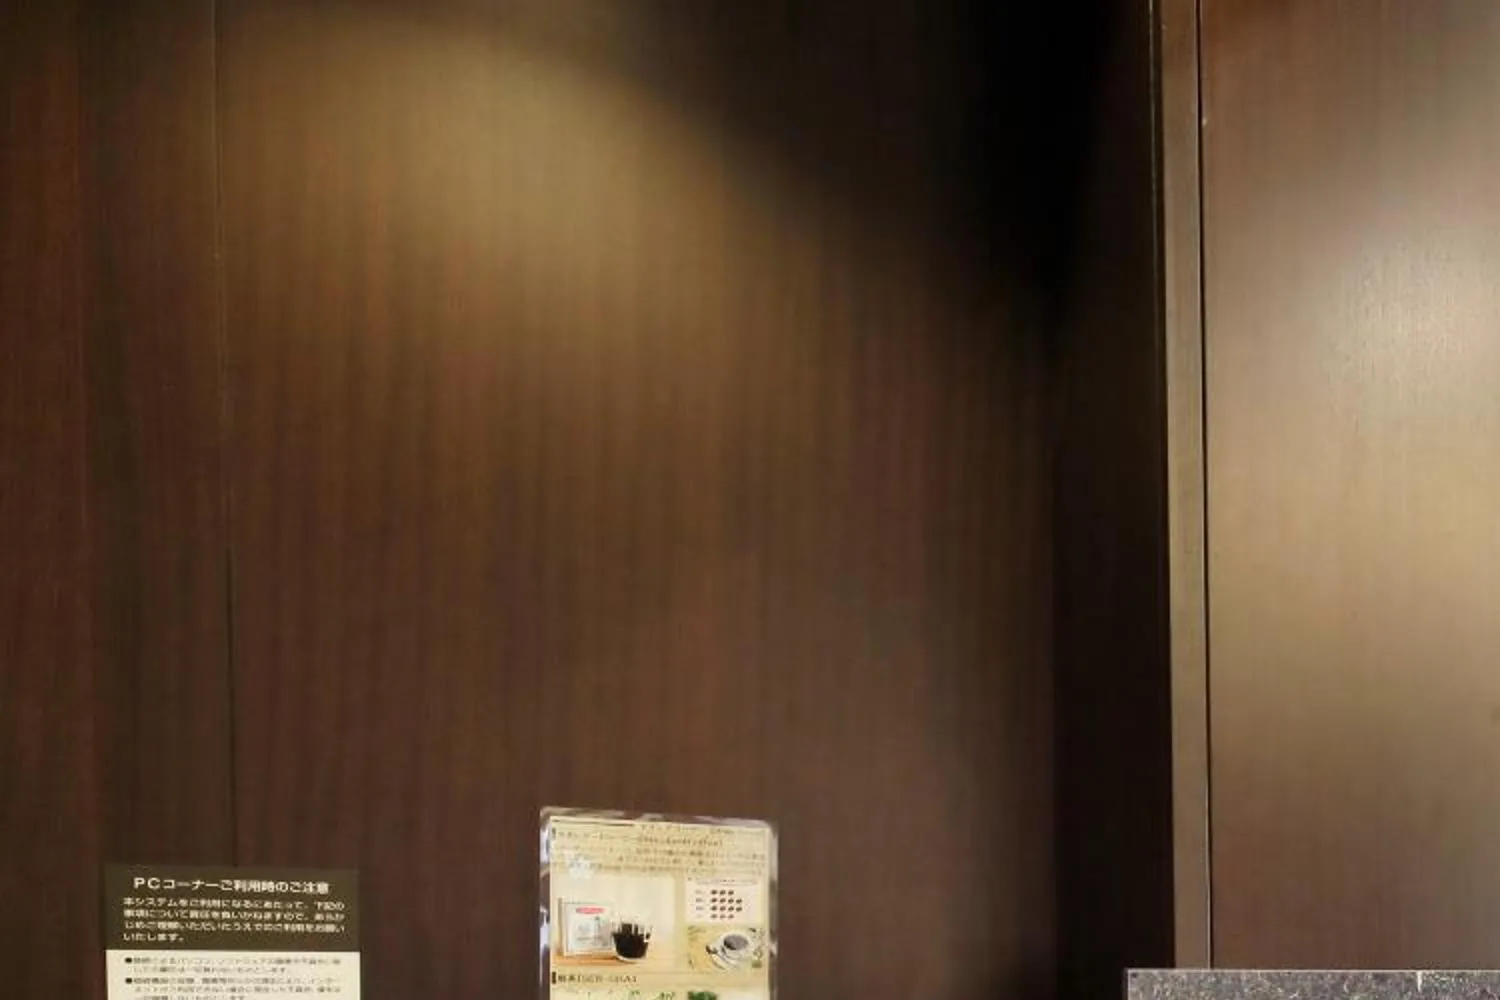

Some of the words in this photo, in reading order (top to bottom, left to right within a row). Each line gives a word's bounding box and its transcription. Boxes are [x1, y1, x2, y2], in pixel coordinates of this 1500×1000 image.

[133, 876, 330, 895] PCコーナーご利用時のご注意
